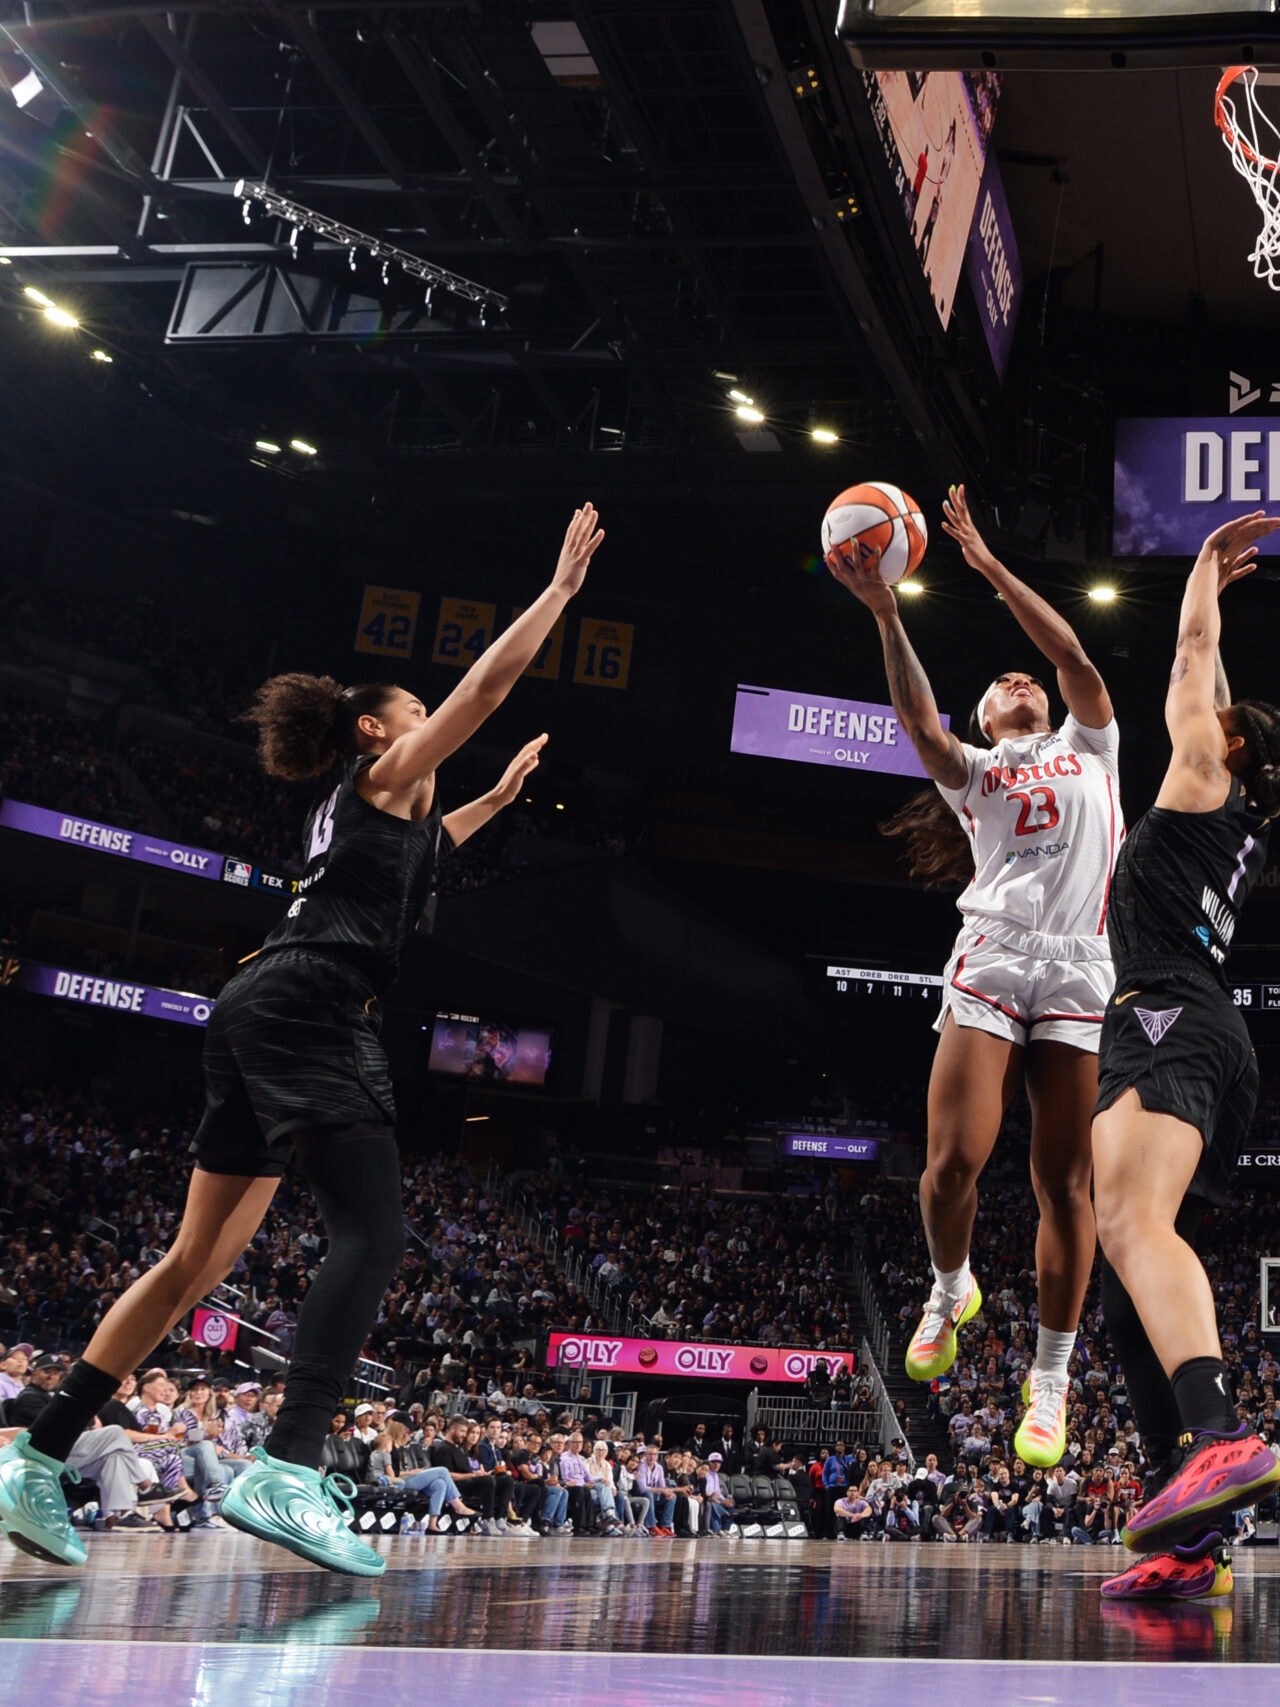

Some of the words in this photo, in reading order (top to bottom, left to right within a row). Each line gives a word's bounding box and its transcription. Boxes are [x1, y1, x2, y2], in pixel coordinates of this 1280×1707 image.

[981, 189, 1014, 326] DEFENSE
[363, 612, 411, 649] 42
[439, 622, 487, 660] 24
[583, 643, 622, 680] 16
[788, 704, 898, 746] DEFENSE
[834, 748, 870, 765] OLLY
[1006, 786, 1060, 837] 23
[60, 818, 132, 853] DEFENSE
[170, 849, 209, 870] OLLY
[1016, 842, 1070, 860] VANDA
[261, 873, 284, 889] TEX
[834, 968, 852, 976] AST
[859, 970, 883, 979] OREB
[887, 973, 910, 982] DREB
[919, 975, 934, 983] STL
[54, 971, 145, 1012] DEFENSE
[836, 980, 848, 993] 10
[867, 983, 874, 995] 7
[893, 985, 903, 997] 11
[921, 987, 929, 1000] 4
[1233, 989, 1252, 1006] 35
[792, 1140, 828, 1152] DEFENSE
[847, 1145, 868, 1153] OLLY
[562, 1340, 621, 1365] OLLY
[677, 1349, 732, 1372] OLLY
[787, 1355, 839, 1378] OLY
